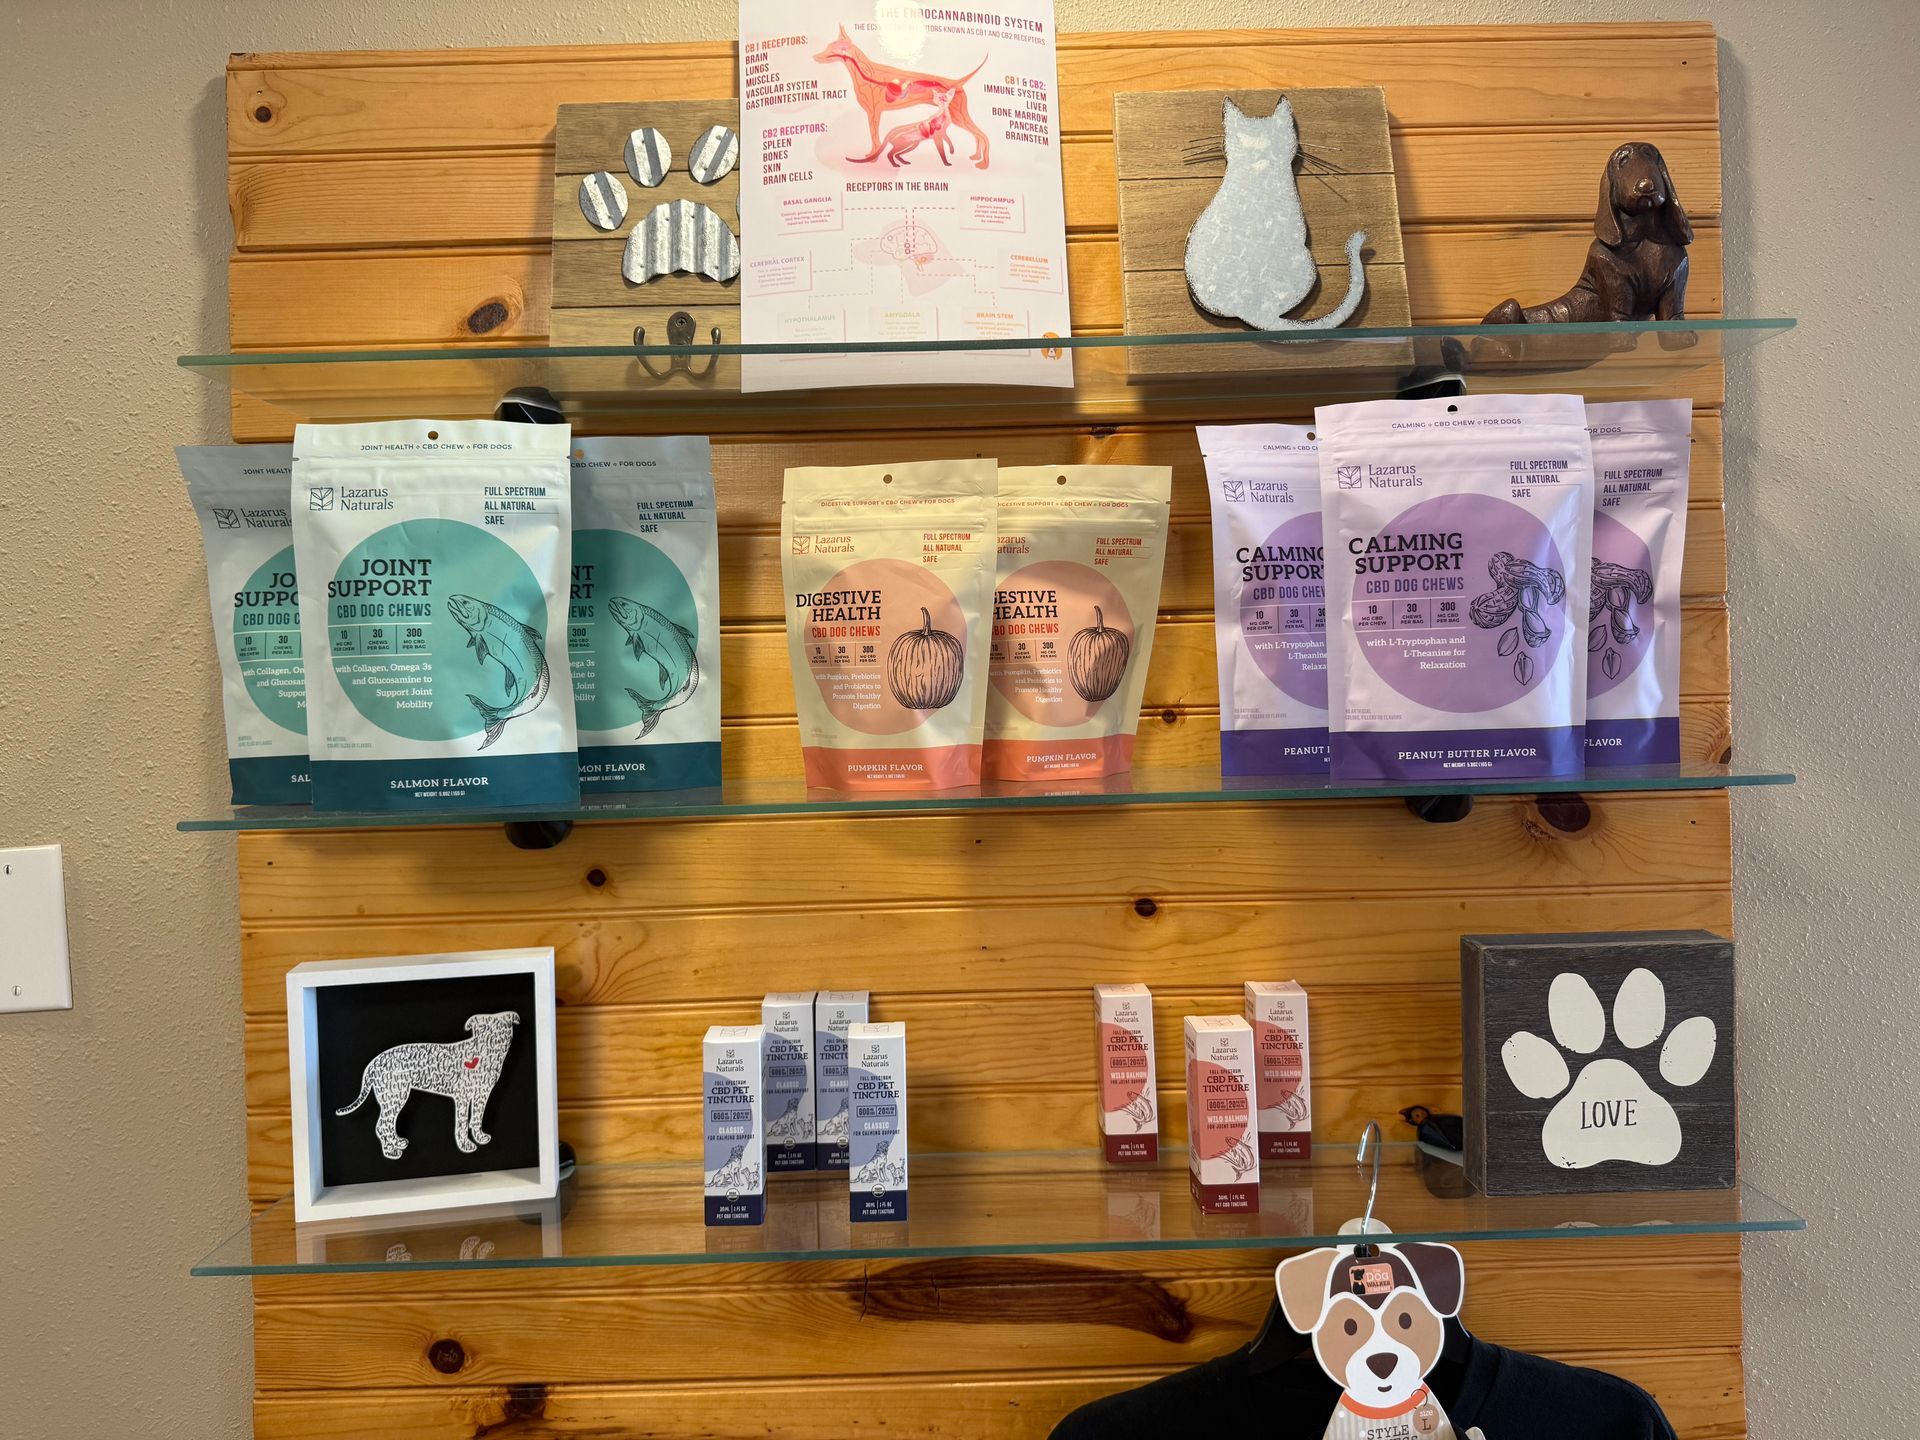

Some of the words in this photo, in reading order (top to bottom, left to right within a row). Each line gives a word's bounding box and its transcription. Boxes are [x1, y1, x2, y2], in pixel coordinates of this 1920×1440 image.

[1005, 16, 1043, 32] SYSTEM
[943, 26, 965, 34] KNOWN
[1014, 34, 1046, 46] RECEPTORS
[762, 36, 808, 50] RECEPTORS:
[746, 52, 768, 64] BRAIN
[746, 63, 769, 76] LUNGS
[746, 73, 780, 88] MUSCLES
[746, 84, 784, 99] VASCULAR
[786, 80, 818, 91] SYSTEM
[984, 84, 1015, 96] IMMUNE
[1018, 88, 1046, 101] SYSTEM
[746, 91, 819, 110] GASTROINTESTINAL
[822, 90, 847, 100] TRACT
[1026, 100, 1047, 112] LIVER
[992, 107, 1012, 117] BONE
[1015, 110, 1047, 123] MARROW
[762, 129, 778, 138] CB2
[780, 123, 828, 136] RECEPTORS:
[1010, 120, 1048, 134] PANCREAS
[762, 138, 792, 150] SPLEEN
[1006, 131, 1048, 146] BRAINSTEM
[763, 150, 788, 162] BONES
[763, 163, 781, 174] SKIN
[763, 174, 786, 186] BRAIN
[789, 171, 813, 181] CELLS
[846, 182, 892, 192] RECEPTORS
[895, 182, 903, 192] IN
[906, 182, 921, 191] THE
[924, 182, 948, 191] BRAIN
[971, 196, 1015, 204] HIPPOCAMPUS
[1369, 464, 1416, 476] Lazarus
[1510, 461, 1528, 470] FULL
[1530, 460, 1568, 470] SPECTRUM
[1511, 475, 1525, 484] ALL
[1527, 474, 1560, 484] NATURAL
[1604, 470, 1621, 479] FULL
[1623, 469, 1662, 478] SPECTRUM
[1249, 480, 1288, 491] Lazarus
[1369, 476, 1423, 489] Naturals
[341, 486, 388, 497] Lazarus
[485, 487, 503, 496] FULL
[504, 487, 546, 497] SPECTRUM
[1512, 489, 1531, 498] SAFE
[1250, 492, 1294, 503] Naturals
[340, 498, 394, 511] Naturals
[485, 501, 499, 510] ALL
[501, 501, 536, 511] NATURAL
[656, 500, 693, 509] SPECTRUM
[241, 508, 287, 518] Lazarus
[485, 515, 504, 525] SAFE
[815, 535, 851, 544] Lazarus
[1348, 532, 1462, 555] CALMING
[814, 544, 854, 554] Naturals
[360, 559, 432, 576] JOINT
[1355, 553, 1464, 575] SUPPORT
[328, 579, 432, 598] SUPPORT
[1366, 580, 1390, 594] CBD
[1395, 579, 1418, 592] DOG
[1423, 577, 1464, 591] CHEWS
[796, 590, 881, 608] DIGESTIVE
[1254, 588, 1275, 600] CBD
[1279, 587, 1298, 598] DOG
[337, 605, 357, 618] CBD
[360, 604, 384, 617] DOG
[388, 604, 432, 616] CHEWS
[1368, 605, 1377, 614] 10
[1407, 603, 1417, 613] 30
[1440, 602, 1456, 611] 300
[812, 606, 881, 622] HEALTH
[372, 628, 383, 638] 30
[406, 628, 422, 638] 300
[812, 627, 827, 638] CBD
[830, 626, 846, 637] DOG
[850, 626, 881, 637] CHEWS
[1008, 624, 1025, 634] DOG
[1029, 623, 1059, 633] CHEWS
[1366, 638, 1386, 646] with
[1389, 637, 1447, 647] L-Tryptophan
[1449, 636, 1466, 644] and
[1404, 649, 1451, 658] L-Theanine
[1453, 648, 1466, 656] for
[335, 664, 351, 673] with
[353, 664, 388, 673] Collagen,
[390, 663, 418, 673] Omega
[1420, 661, 1466, 669] Relaxation
[352, 677, 366, 685] and
[367, 676, 421, 684] Glucosamine
[376, 688, 409, 697] Support
[411, 688, 432, 696] Joint
[396, 700, 433, 709] Mobility
[853, 702, 881, 710] Digestion
[1584, 738, 1622, 746] FLAVOR
[1284, 747, 1324, 755] PEANUT
[1398, 751, 1443, 760] PEANUT
[1447, 750, 1490, 759] BUTTER
[1494, 748, 1537, 757] FLAVOR
[1027, 754, 1063, 763] PUMPKIN
[1066, 753, 1096, 761] FLAVOR
[605, 763, 646, 772] FLAVOR
[391, 779, 439, 789] SALMON
[443, 777, 489, 787] FLAVOR
[1107, 1044, 1148, 1052] TINCTURE
[1260, 1042, 1303, 1050] TINCTURE
[1207, 1076, 1226, 1084] CBD
[733, 1086, 749, 1094] PET
[1203, 1084, 1249, 1092] TINCTURE
[707, 1095, 754, 1104] TINCTURE
[853, 1090, 900, 1099] TINCTURE
[1580, 1099, 1637, 1129] LOVE
[1365, 1271, 1389, 1281] DOG
[1422, 1419, 1431, 1431] L
[1367, 1424, 1409, 1440] STYLE
